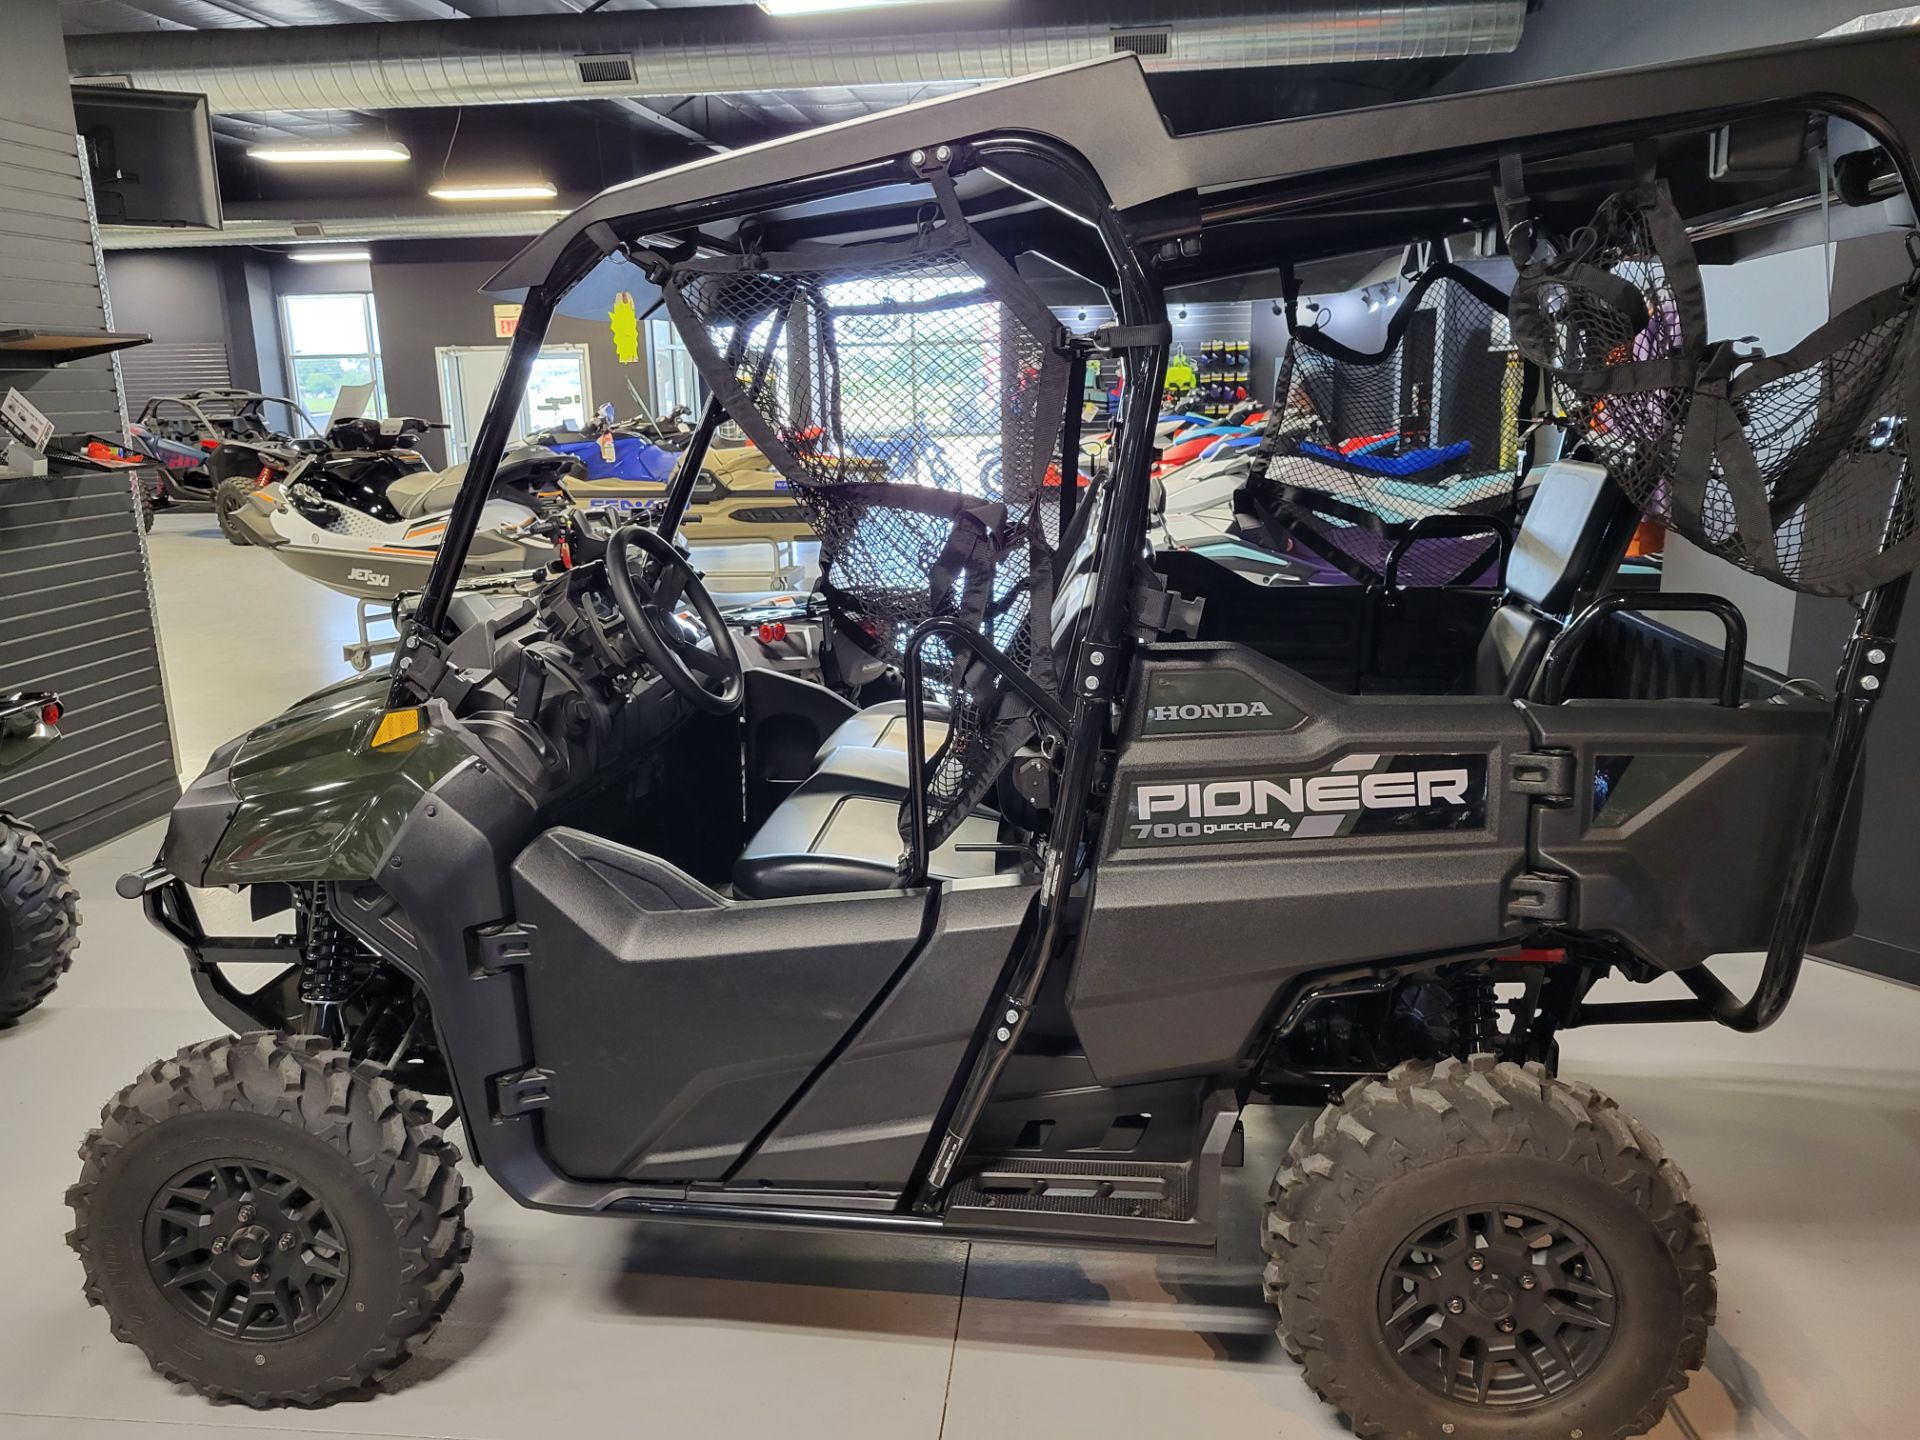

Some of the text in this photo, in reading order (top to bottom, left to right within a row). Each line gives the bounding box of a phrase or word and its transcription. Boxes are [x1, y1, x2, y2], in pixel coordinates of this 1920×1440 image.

[501, 319, 520, 335] EXI
[1154, 701, 1273, 721] HONDA
[1137, 769, 1469, 820] PIONEER
[1129, 822, 1201, 839] 700
